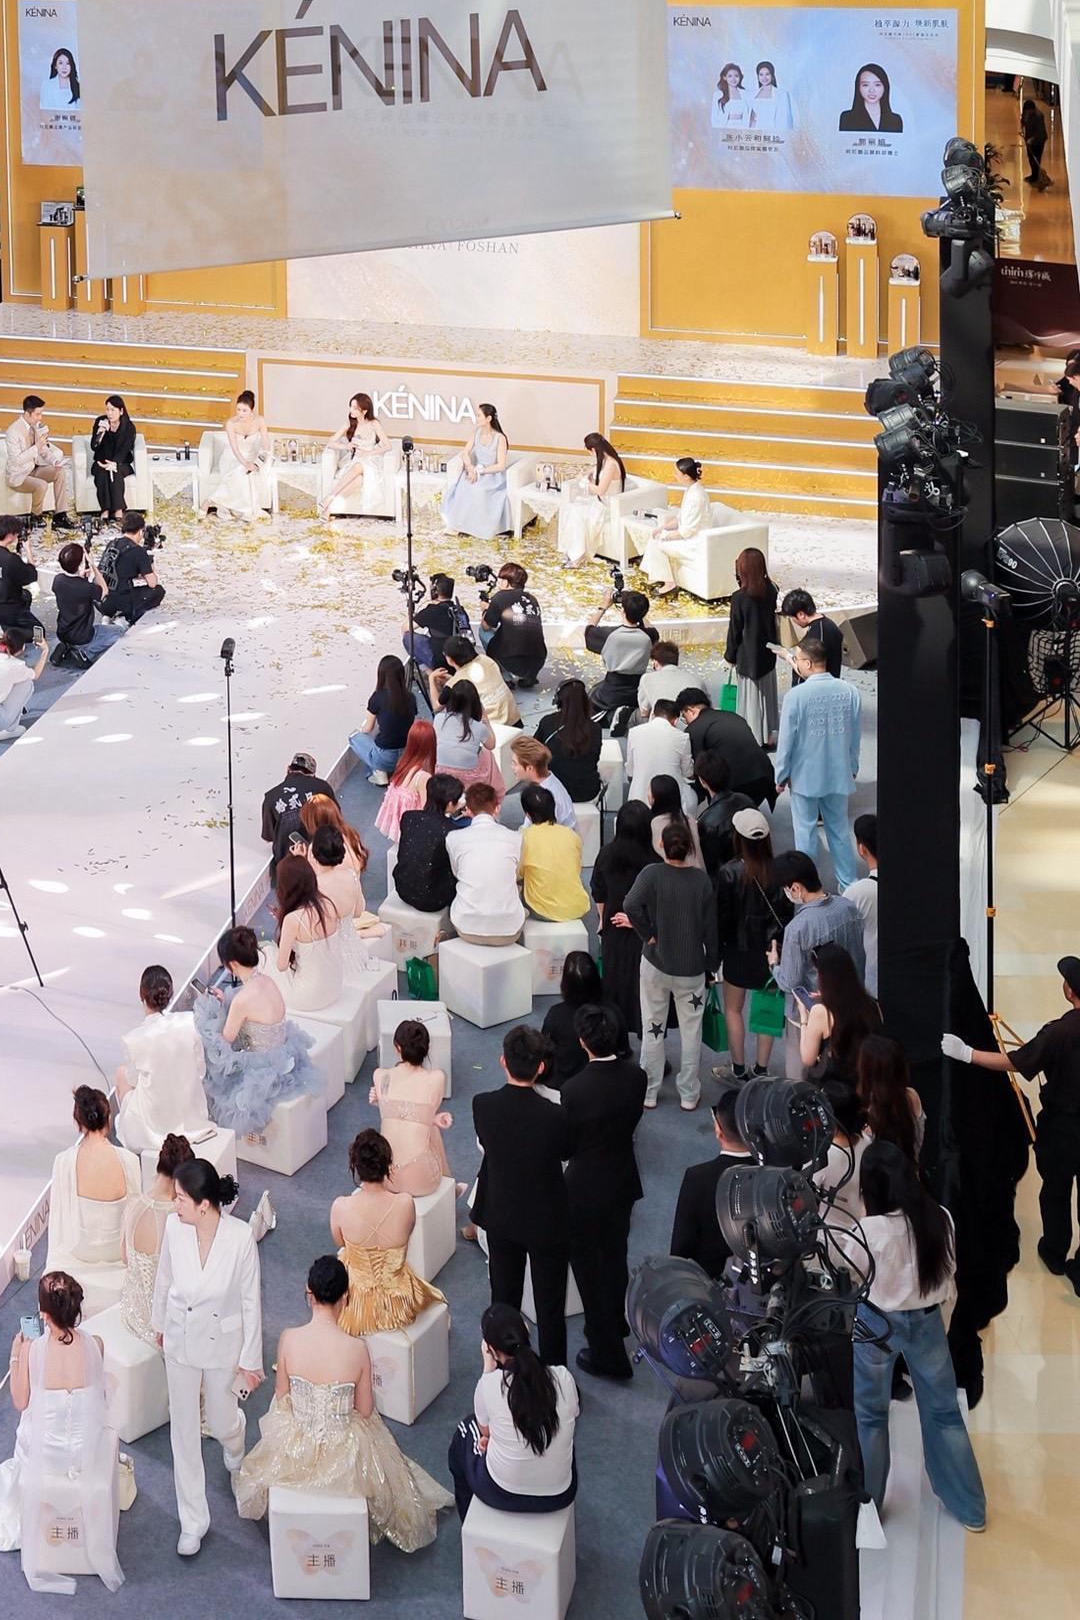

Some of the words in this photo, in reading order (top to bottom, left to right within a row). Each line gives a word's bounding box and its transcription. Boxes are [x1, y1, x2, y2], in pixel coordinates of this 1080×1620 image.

[25, 7, 58, 18] KÉNINA
[673, 14, 711, 27] KÉNINA
[457, 240, 520, 254] FOSHAN
[373, 384, 477, 425] KÉNINA
[51, 1526, 80, 1540] 主播
[307, 1553, 336, 1568] 主播
[495, 1576, 524, 1596] 主播
